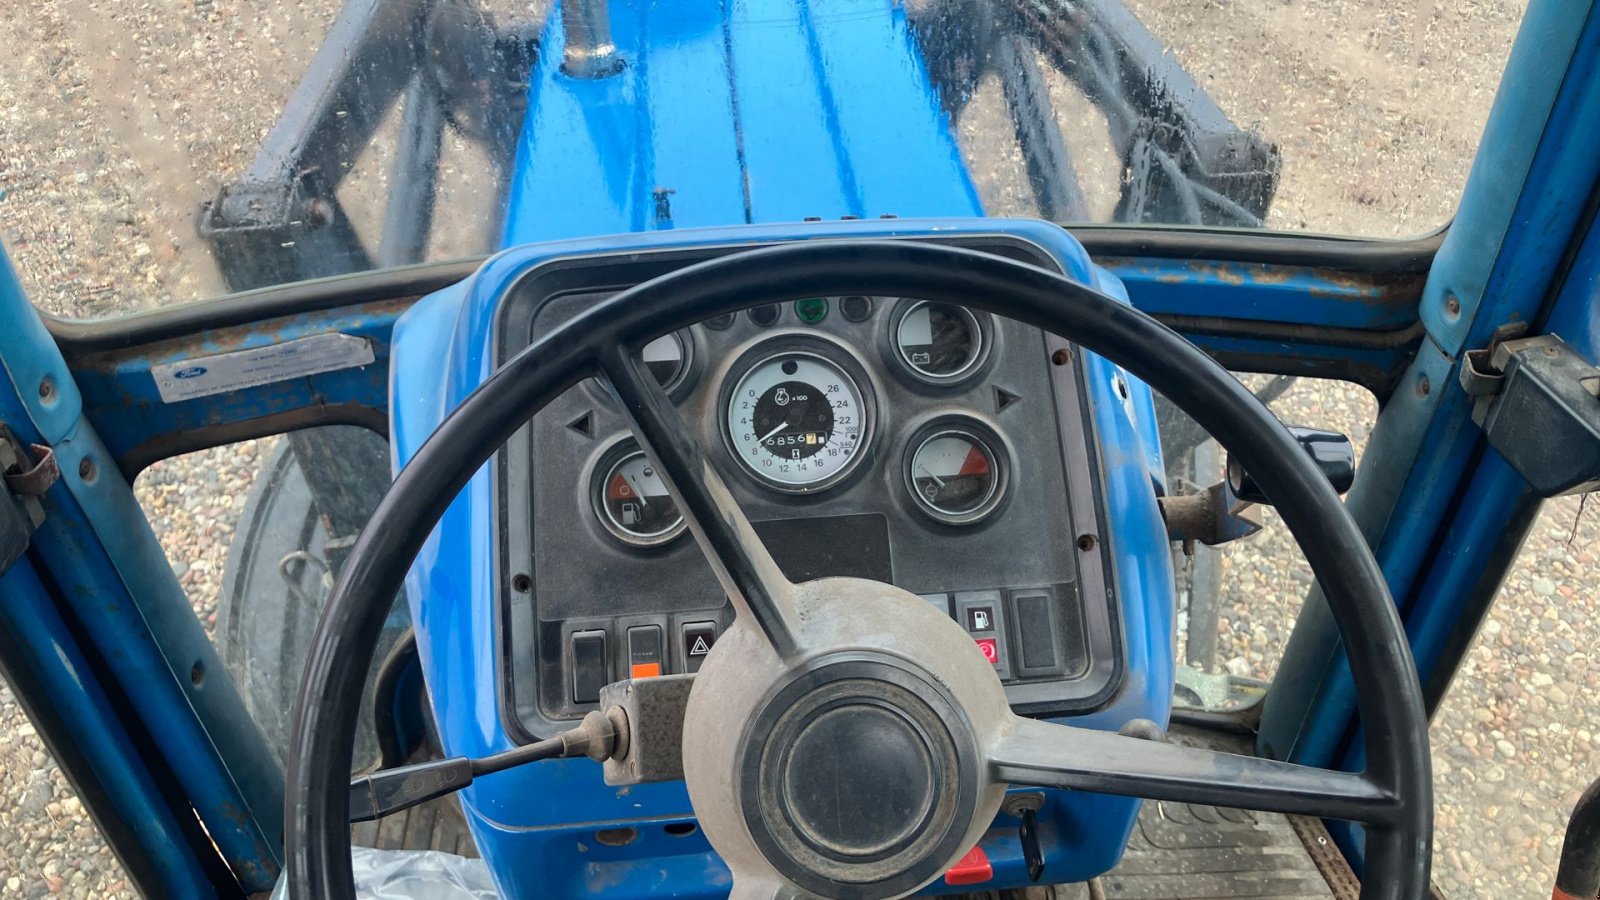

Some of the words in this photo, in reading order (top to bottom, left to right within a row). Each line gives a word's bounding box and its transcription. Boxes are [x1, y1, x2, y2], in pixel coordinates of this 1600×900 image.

[749, 389, 755, 397] 0
[827, 385, 839, 393] 26
[742, 401, 749, 409] 2
[836, 400, 848, 408] 24
[740, 417, 747, 425] 4
[838, 416, 851, 424] 22
[744, 433, 750, 441] 6
[752, 448, 758, 456] 8
[827, 448, 838, 456] 18
[762, 459, 772, 467] 10
[797, 463, 807, 471] 14
[814, 459, 824, 467] 16
[779, 465, 789, 473] 12
